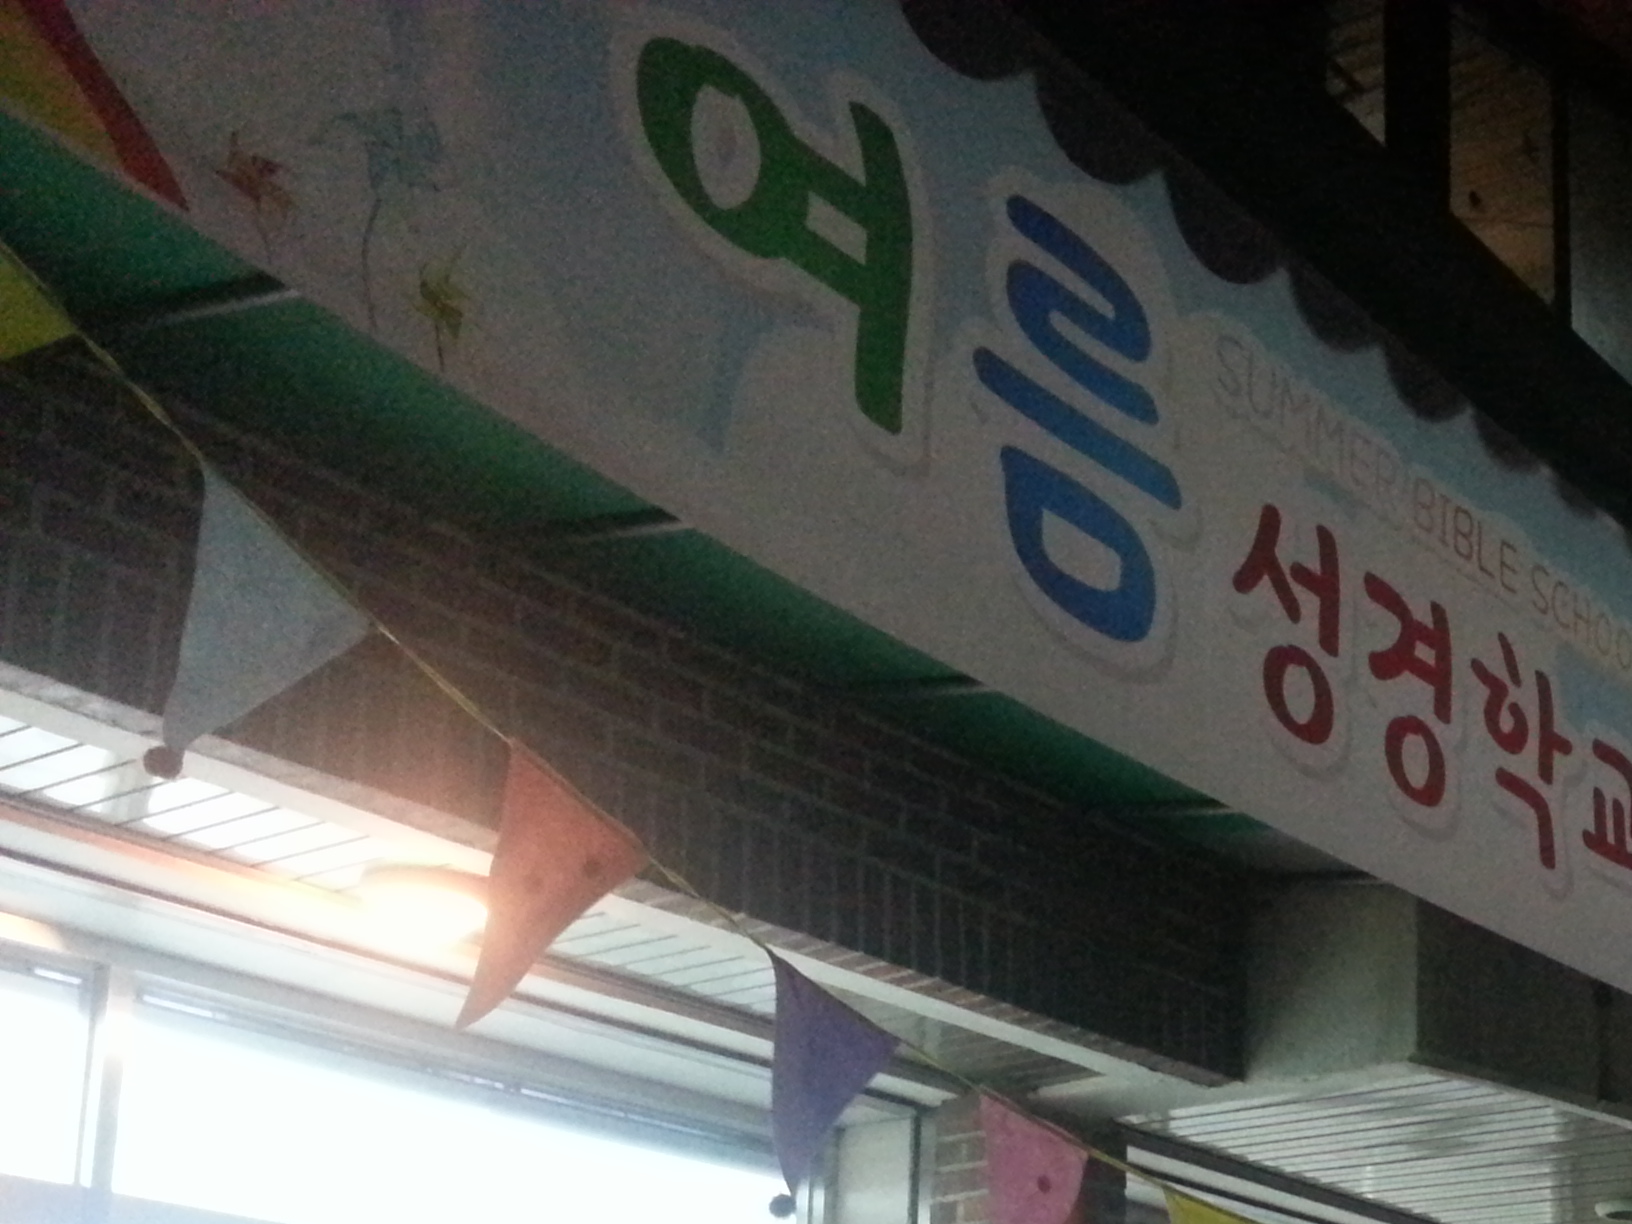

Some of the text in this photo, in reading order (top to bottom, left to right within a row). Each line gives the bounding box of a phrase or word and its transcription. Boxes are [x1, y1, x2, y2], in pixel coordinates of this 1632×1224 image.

[636, 36, 1184, 643] 여름
[1215, 335, 1397, 496] SUMMER
[1411, 477, 1519, 597] BIBLE
